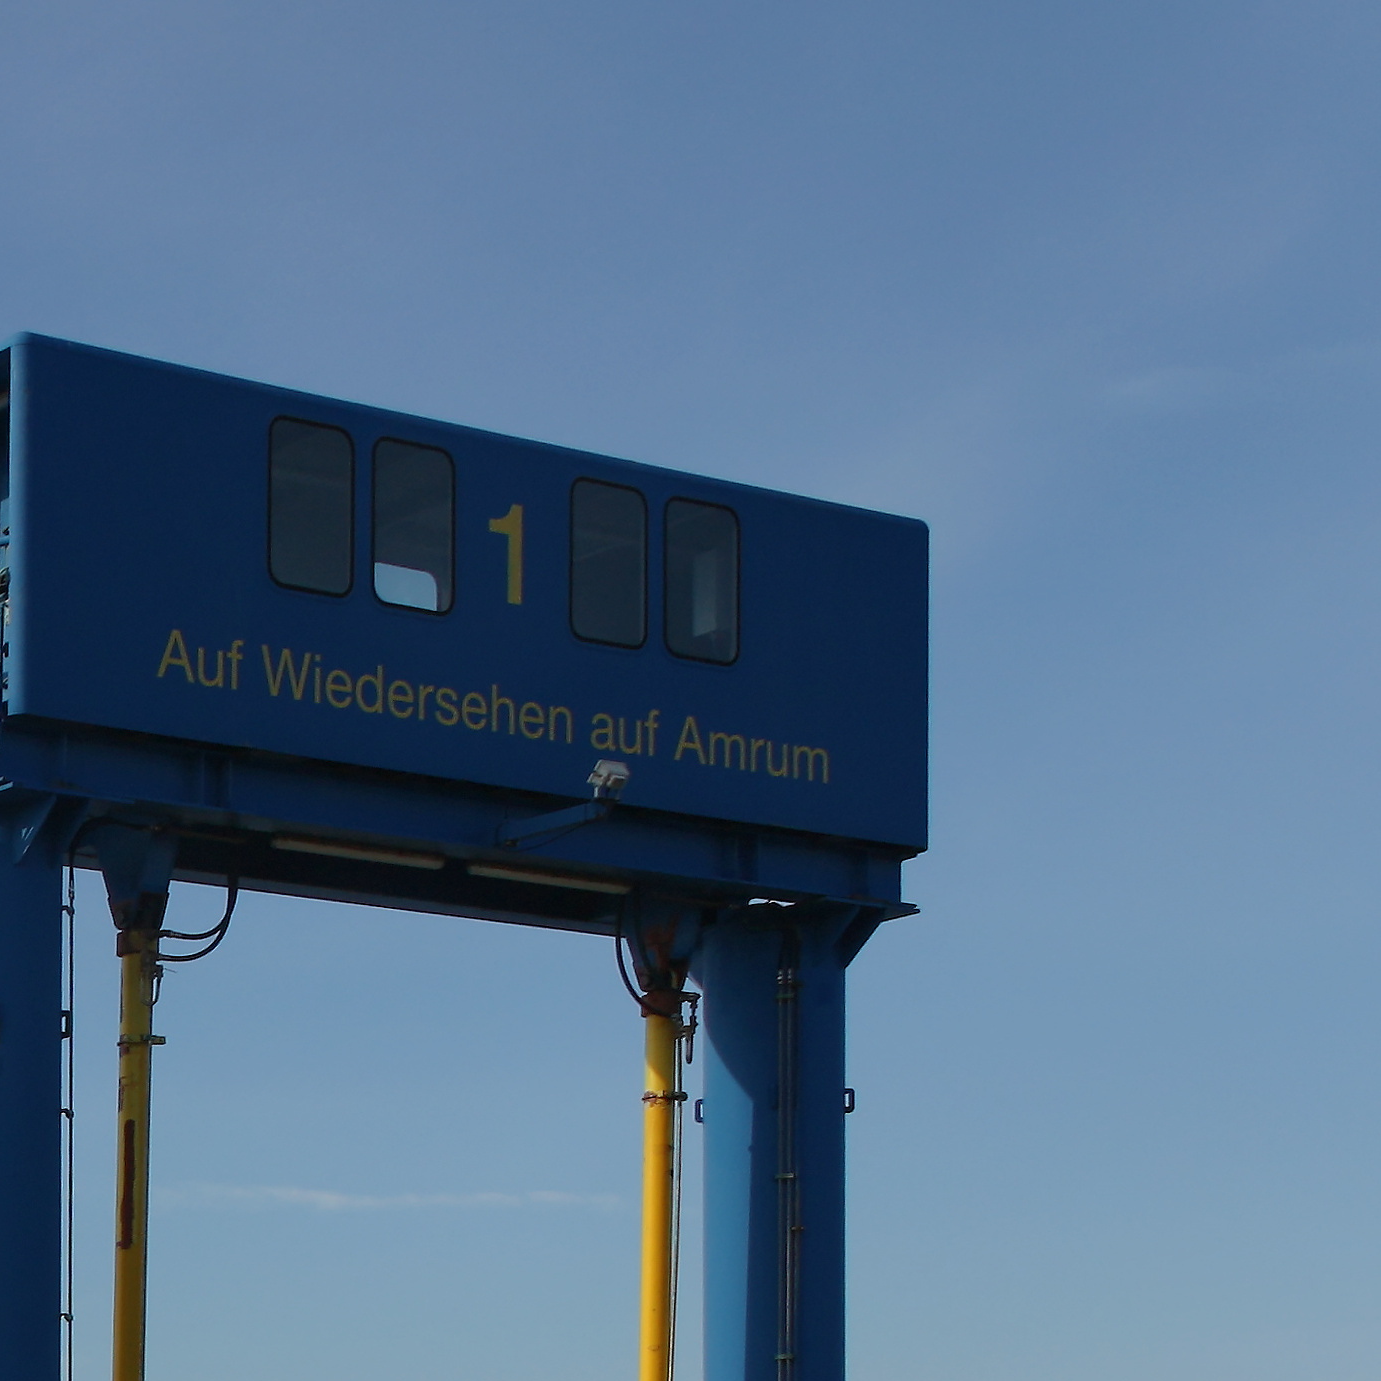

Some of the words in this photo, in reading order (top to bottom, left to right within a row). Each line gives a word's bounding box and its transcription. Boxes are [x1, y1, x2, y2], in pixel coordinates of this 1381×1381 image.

[488, 504, 524, 605] 1
[157, 629, 245, 691] Auf
[260, 643, 573, 745] Wiedersehen
[590, 709, 661, 757] auf
[674, 716, 831, 784] Amrum
